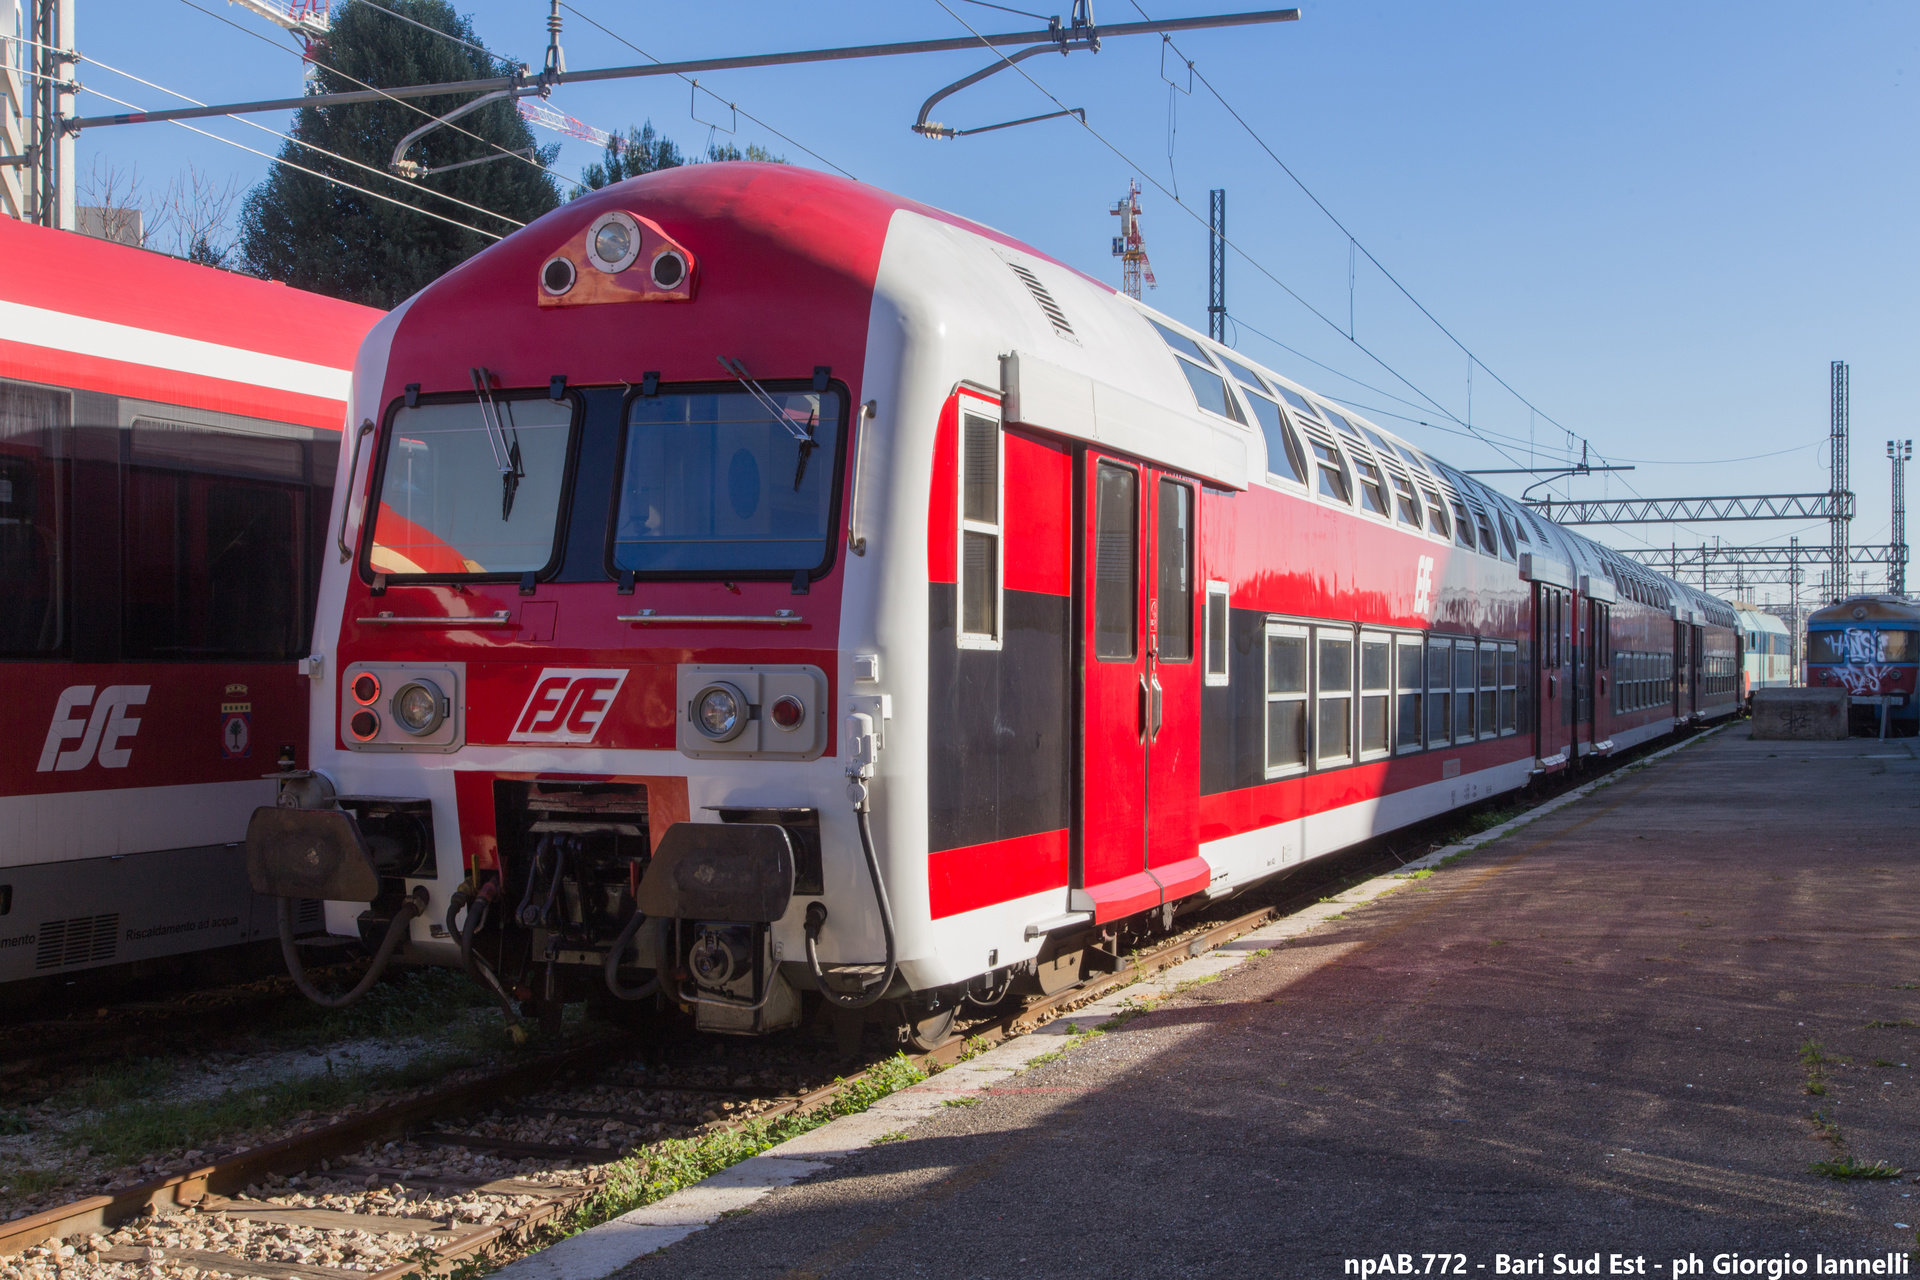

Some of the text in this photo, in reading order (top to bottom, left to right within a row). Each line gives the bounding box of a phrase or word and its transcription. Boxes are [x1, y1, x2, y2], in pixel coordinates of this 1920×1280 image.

[125, 915, 239, 941] Riscaldamento ad acqua
